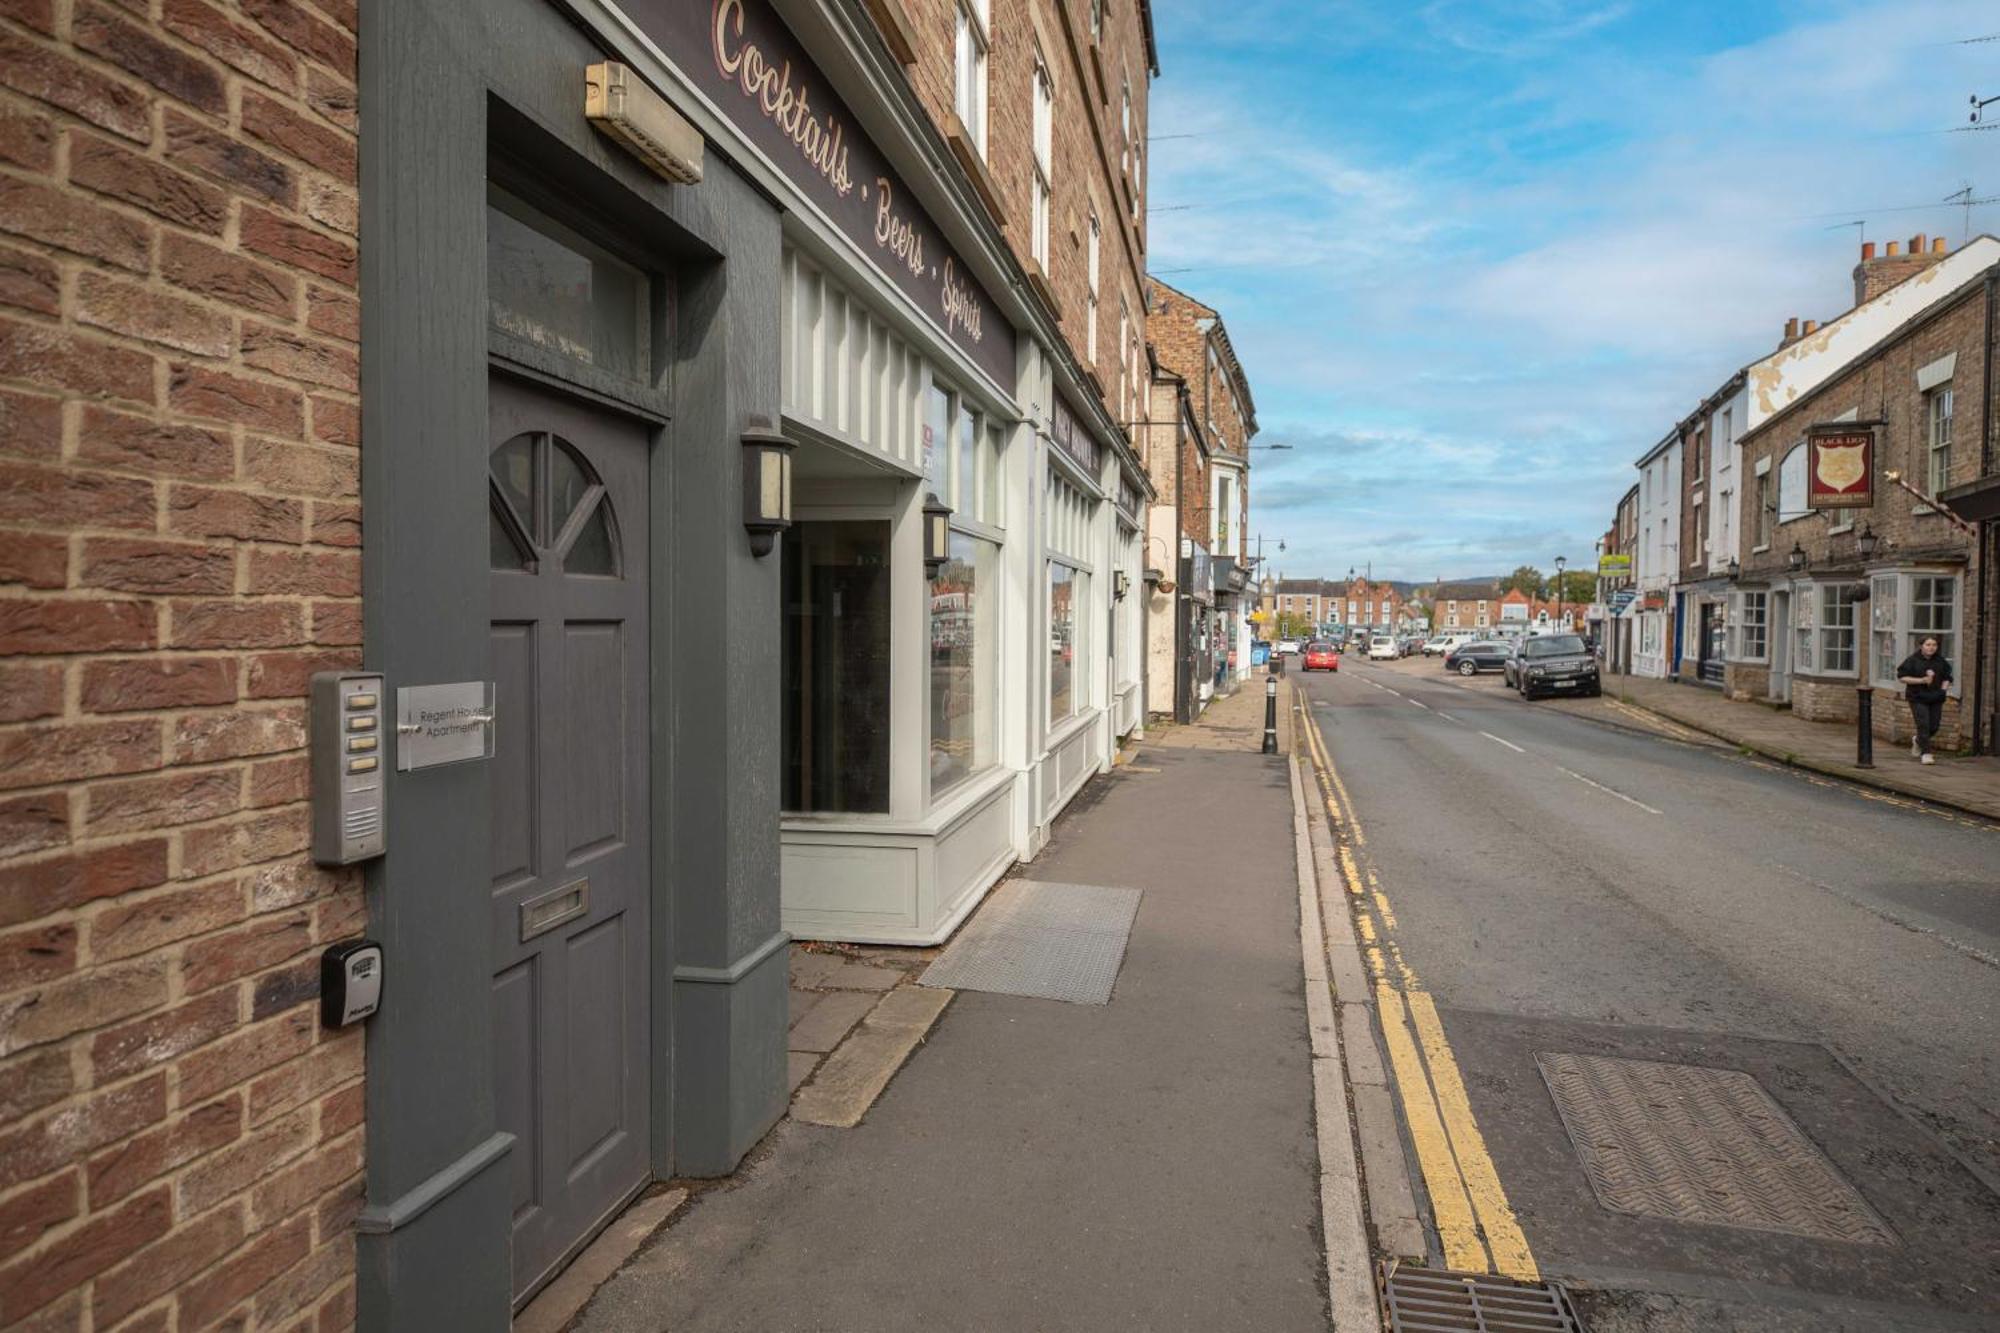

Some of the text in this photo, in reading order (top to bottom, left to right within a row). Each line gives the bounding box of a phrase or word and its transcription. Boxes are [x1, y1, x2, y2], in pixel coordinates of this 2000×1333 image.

[712, 0, 983, 343] Cocktails Beers Spirits
[420, 709, 455, 723] Regent
